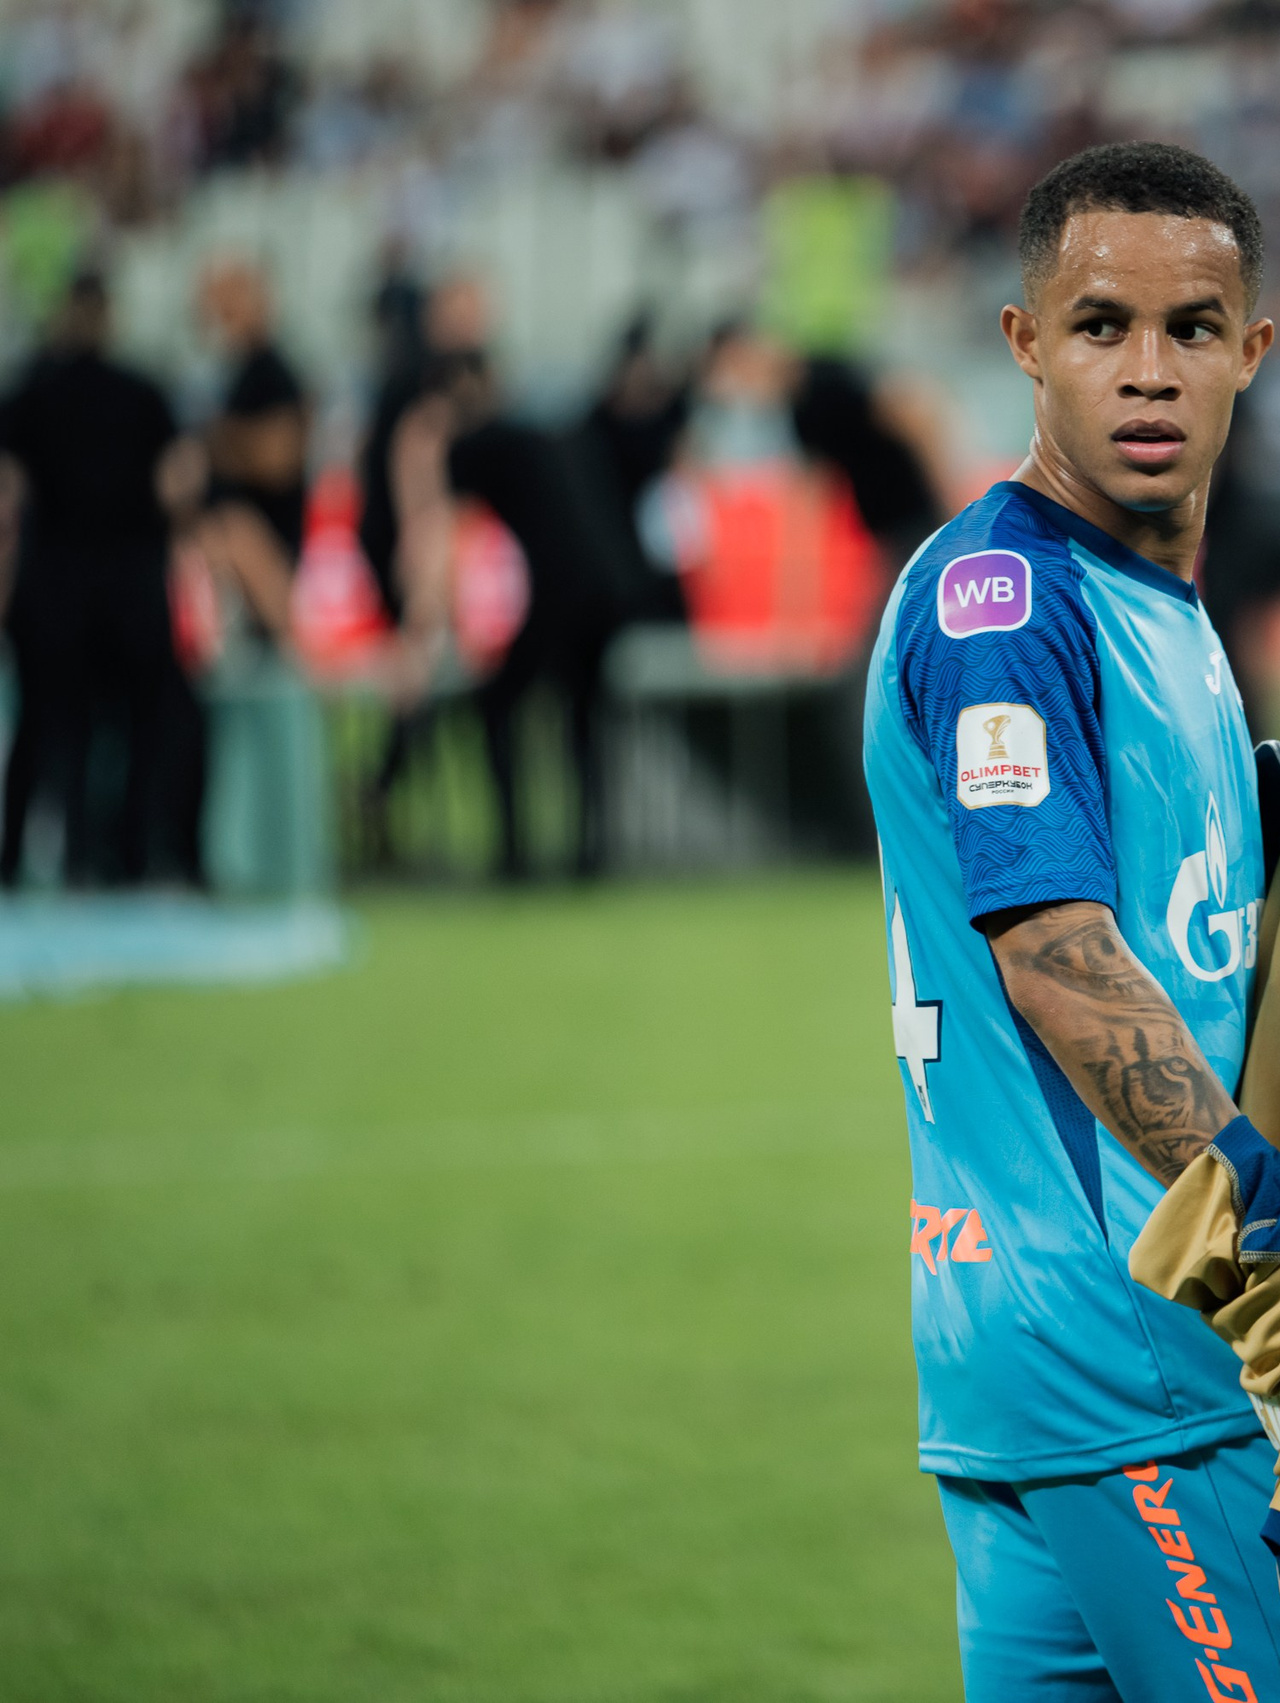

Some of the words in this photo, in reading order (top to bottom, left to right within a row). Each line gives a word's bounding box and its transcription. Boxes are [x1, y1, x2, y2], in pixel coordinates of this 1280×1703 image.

[954, 576, 1015, 608] WB
[960, 764, 1042, 782] OLIMPBET
[968, 780, 1033, 792] СУПЕРКУБОК
